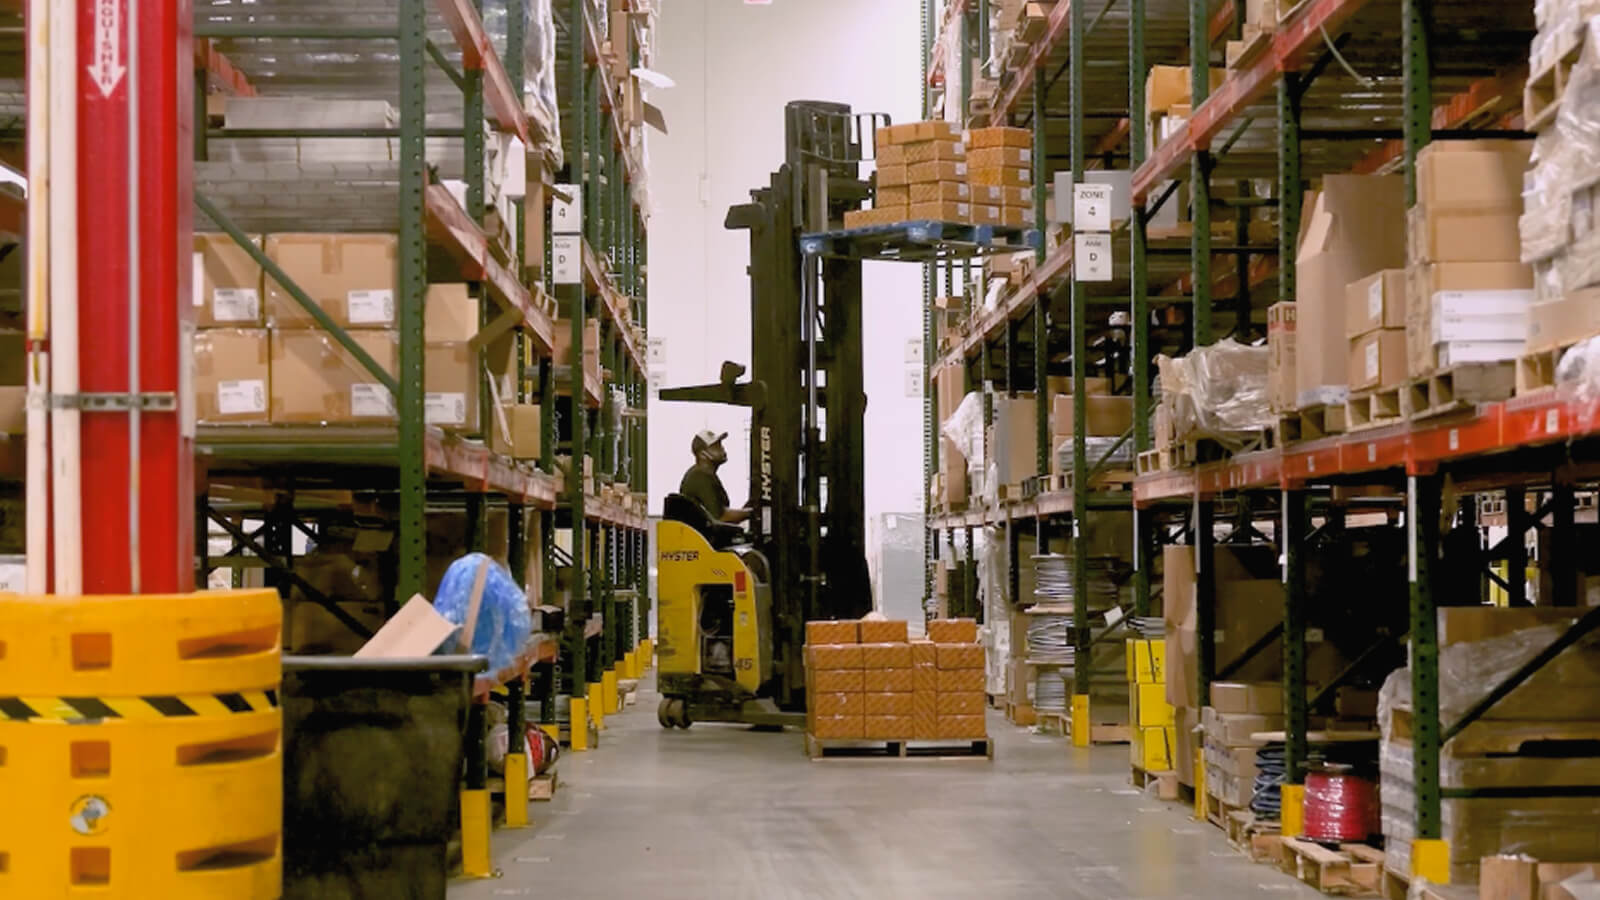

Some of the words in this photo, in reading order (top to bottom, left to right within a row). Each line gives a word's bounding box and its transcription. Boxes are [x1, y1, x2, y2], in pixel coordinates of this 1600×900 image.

[1080, 191, 1104, 199] ZONE
[559, 208, 566, 218] 4
[1088, 206, 1096, 216] 4
[559, 255, 566, 264] D
[1089, 253, 1097, 261] D
[761, 426, 772, 501] HYSTER
[660, 549, 700, 562] HYSTER
